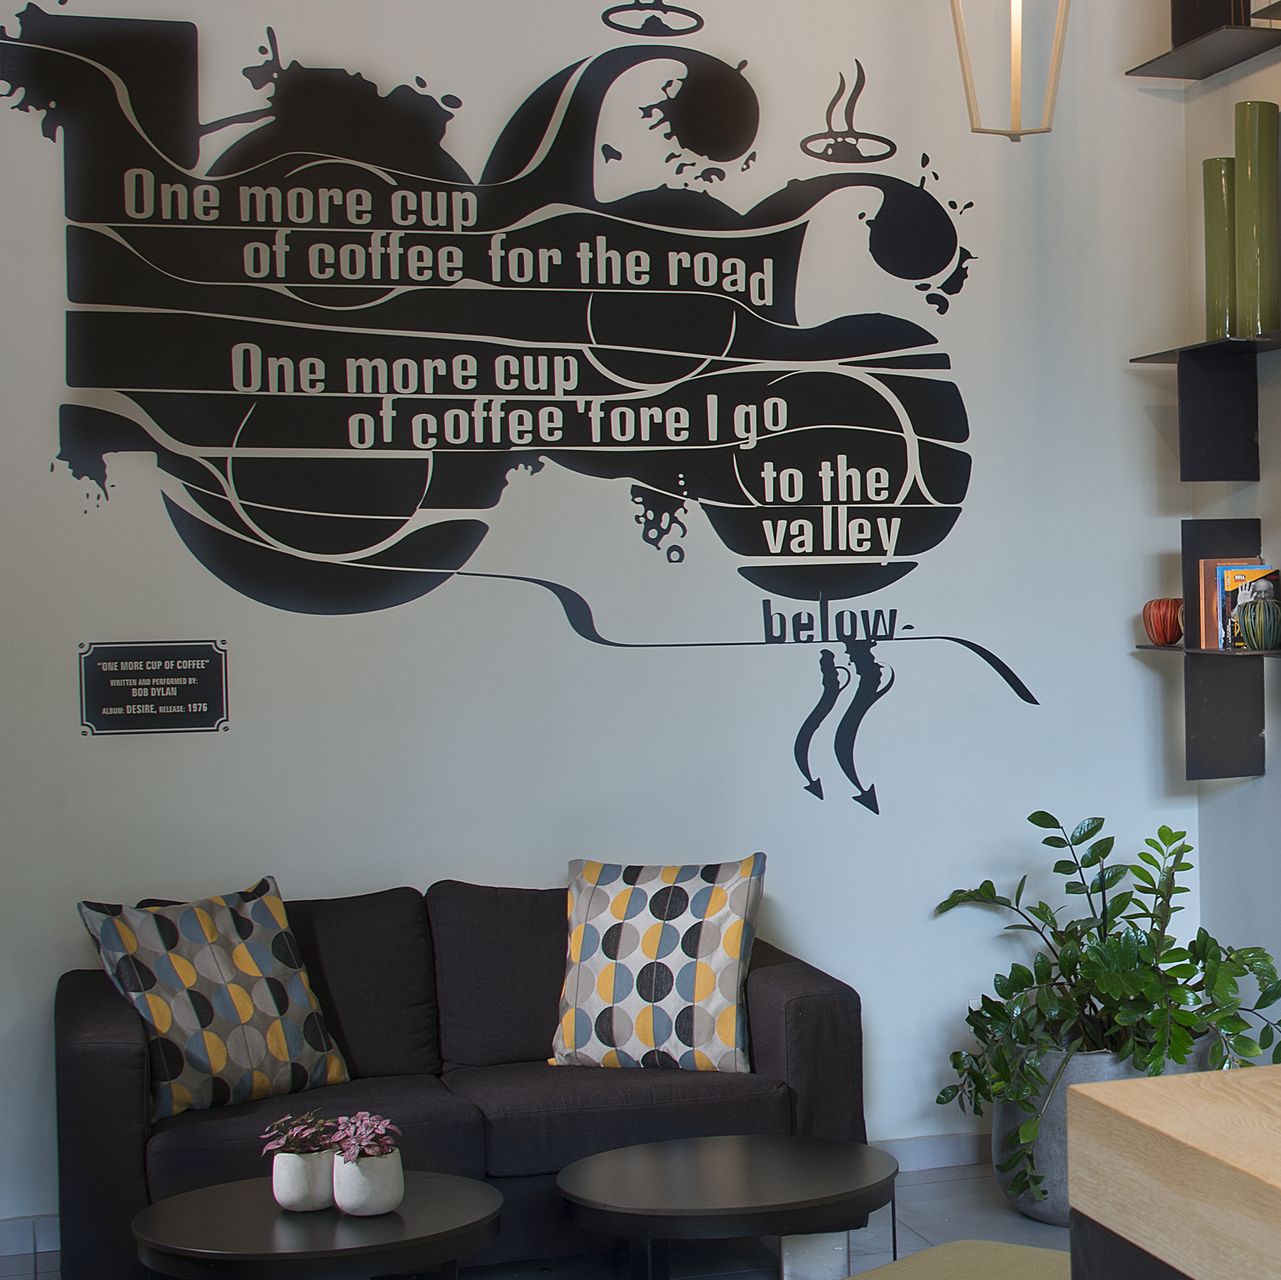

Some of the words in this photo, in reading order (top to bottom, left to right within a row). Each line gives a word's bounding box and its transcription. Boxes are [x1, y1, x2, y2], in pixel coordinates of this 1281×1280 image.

[124, 168, 221, 221] One
[239, 185, 372, 226] more
[390, 190, 479, 233] cup
[243, 229, 290, 280] of
[308, 231, 465, 282] coffee
[488, 233, 563, 284] for
[576, 235, 651, 287] the
[668, 250, 774, 307] road
[230, 343, 327, 395] One
[345, 352, 478, 395] more
[494, 353, 579, 399] cup
[347, 397, 397, 450] of
[410, 398, 564, 450] coffee
[706, 394, 718, 441] I
[733, 396, 788, 450] go
[761, 461, 804, 503] to
[818, 454, 890, 502] the
[762, 505, 902, 566] valley
[762, 593, 898, 644] below
[110, 678, 137, 686] WRITTEN
[138, 678, 151, 686] AND
[152, 677, 187, 686] PERFORMED
[120, 661, 144, 671] MORE
[146, 660, 162, 671] CUP
[164, 660, 175, 670] OF
[102, 706, 125, 715] ALBUM:
[126, 704, 157, 714] DESIRE,
[159, 705, 186, 713] RELEASE:
[187, 703, 208, 712] 1976
[131, 687, 149, 697] BOB
[151, 687, 177, 697] DYLAN
